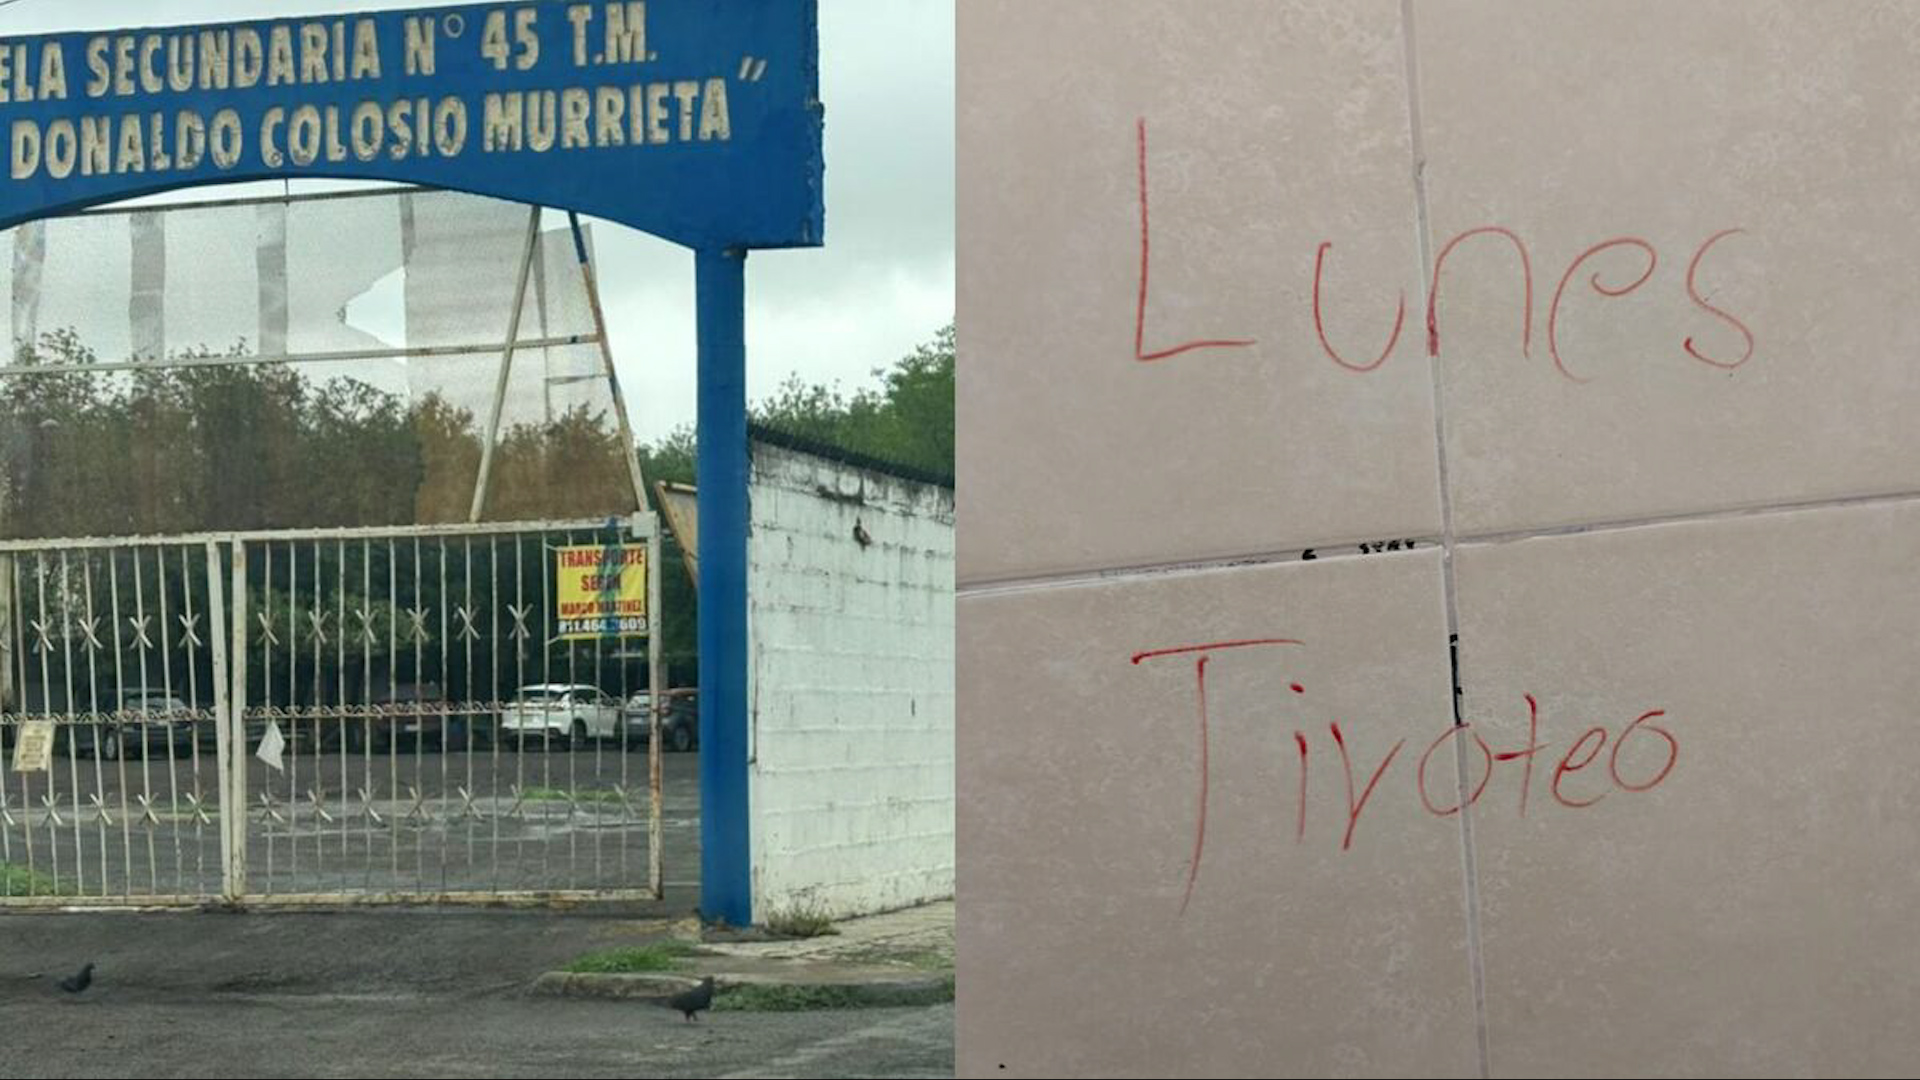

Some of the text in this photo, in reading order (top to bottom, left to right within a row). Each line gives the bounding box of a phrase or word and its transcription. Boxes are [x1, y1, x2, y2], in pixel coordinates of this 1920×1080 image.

[86, 18, 382, 98] SECUNDARIA
[480, 8, 541, 71] 45
[567, 2, 658, 67] T.M.
[11, 107, 243, 180] DONALDO
[260, 95, 467, 168] COLOSIO
[1135, 116, 1754, 384] Lunes
[561, 549, 644, 569] TRANSPORTE
